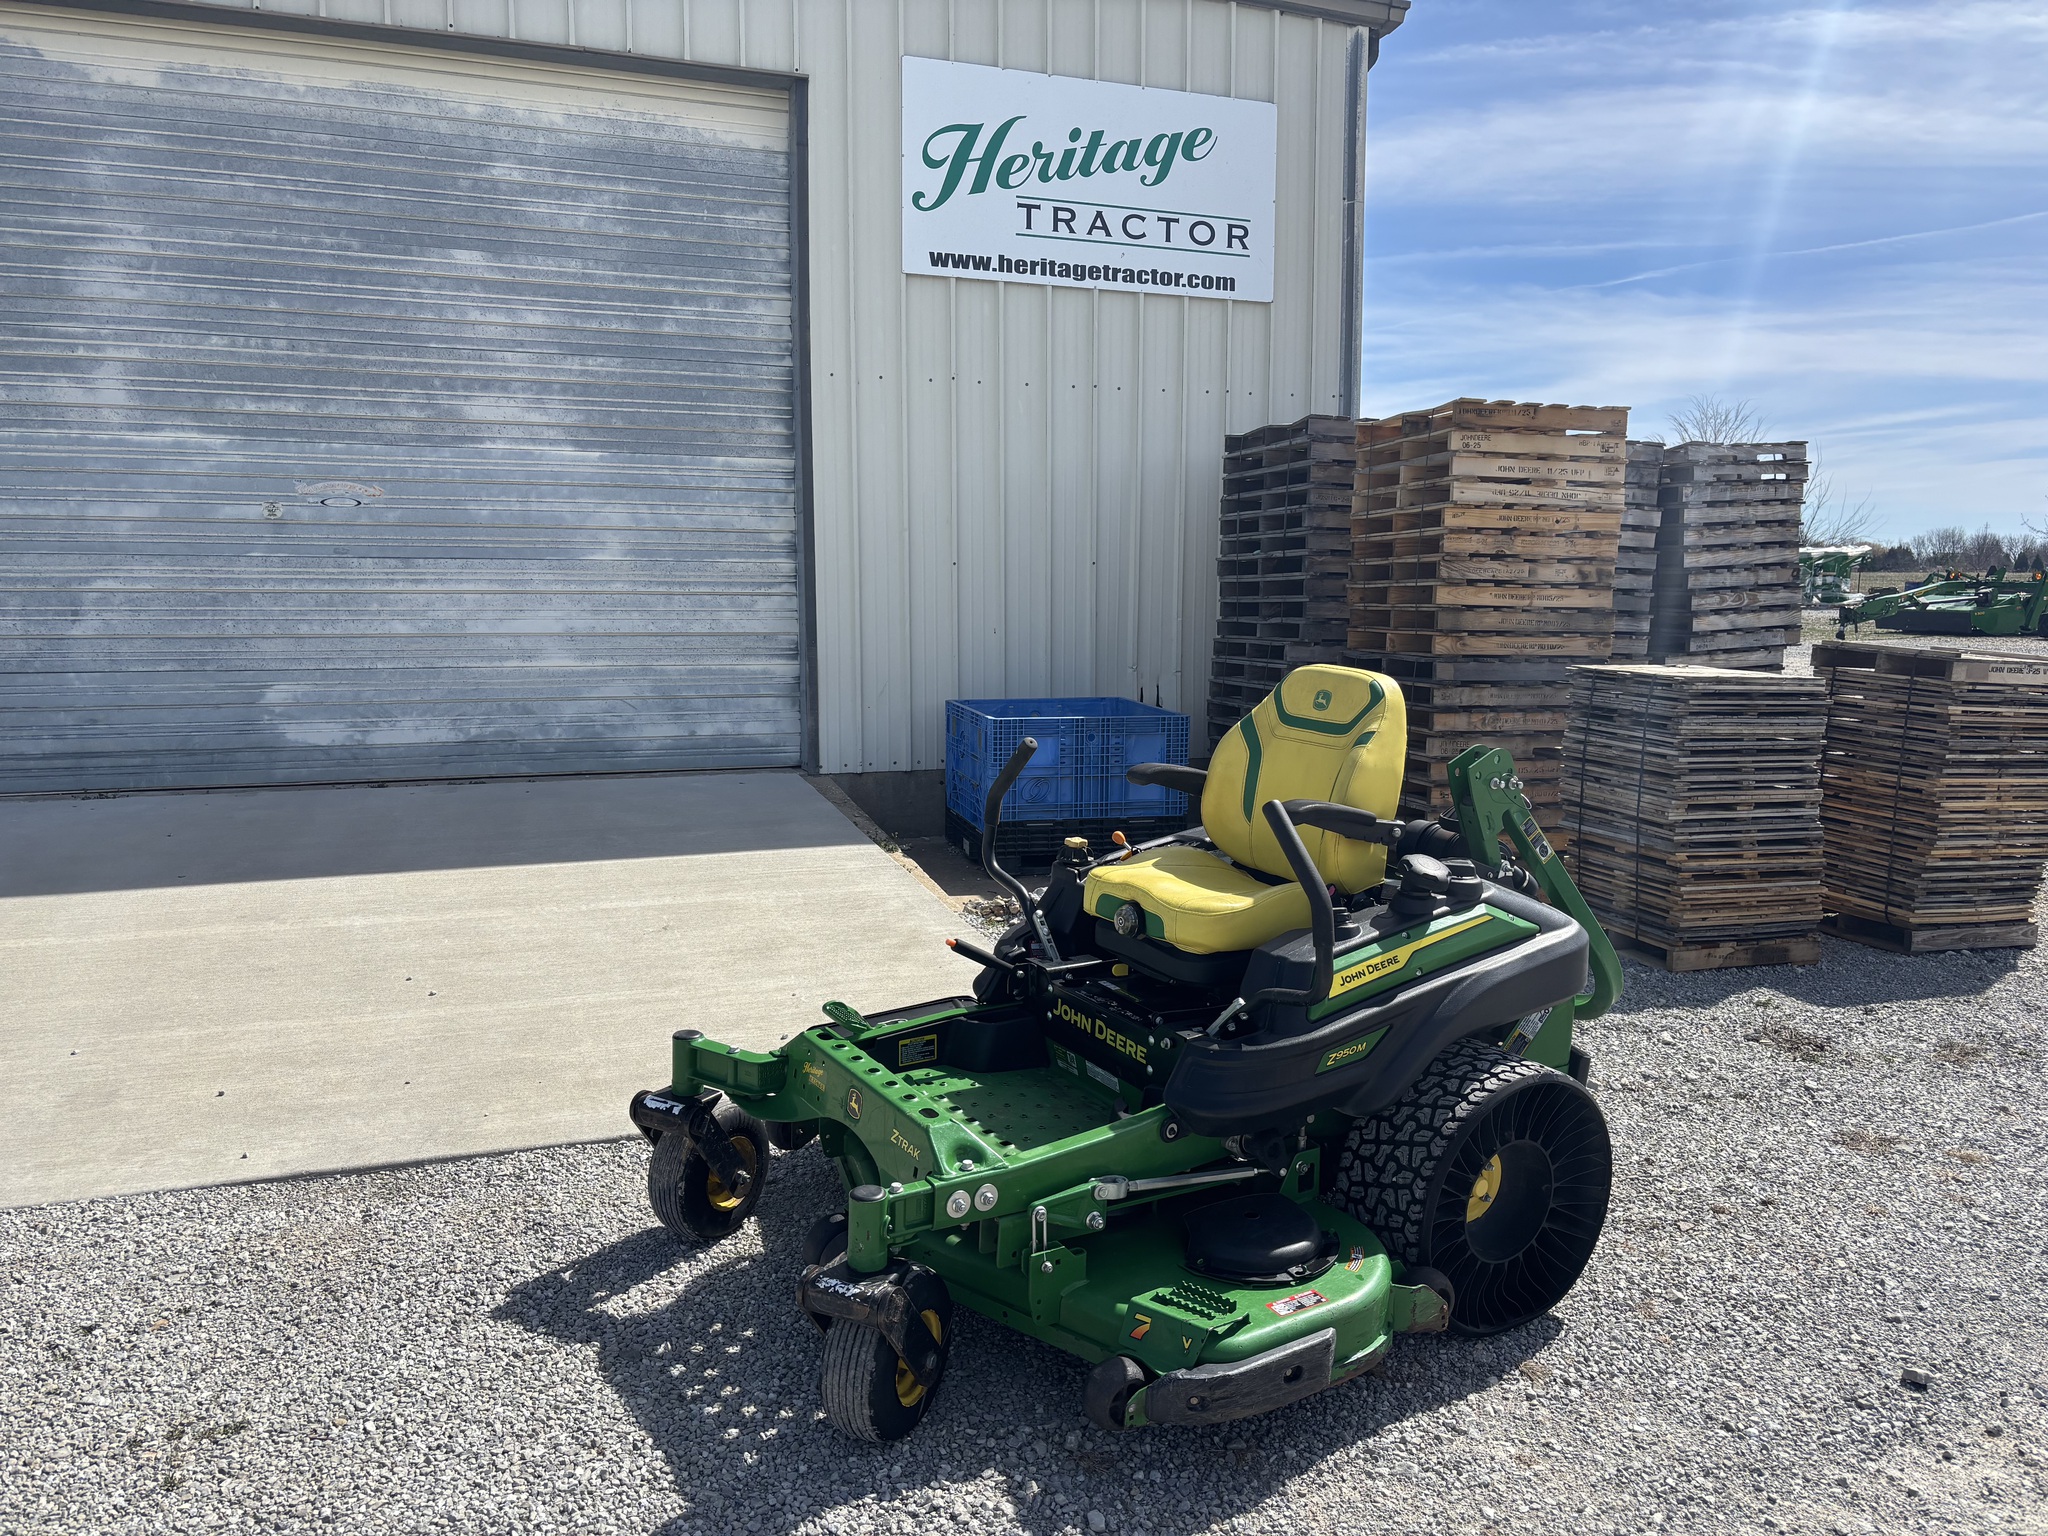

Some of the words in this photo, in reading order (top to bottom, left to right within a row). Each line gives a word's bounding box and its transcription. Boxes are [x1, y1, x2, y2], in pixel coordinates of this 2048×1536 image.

[912, 116, 1218, 211] Heritage
[1016, 202, 1250, 250] TRACTOR
[929, 251, 1236, 292] www.heritagetractor.com
[1495, 465, 1515, 473] JOHN
[1518, 466, 1541, 474] DEERE
[1340, 969, 1366, 987] JOHN
[1366, 955, 1400, 975] DEERE
[1053, 998, 1092, 1034] JOHN
[1094, 1018, 1147, 1065] DEERE
[1326, 1042, 1367, 1066] Z950M
[890, 1128, 921, 1161] ZTRAK
[1129, 1312, 1152, 1341] 7
